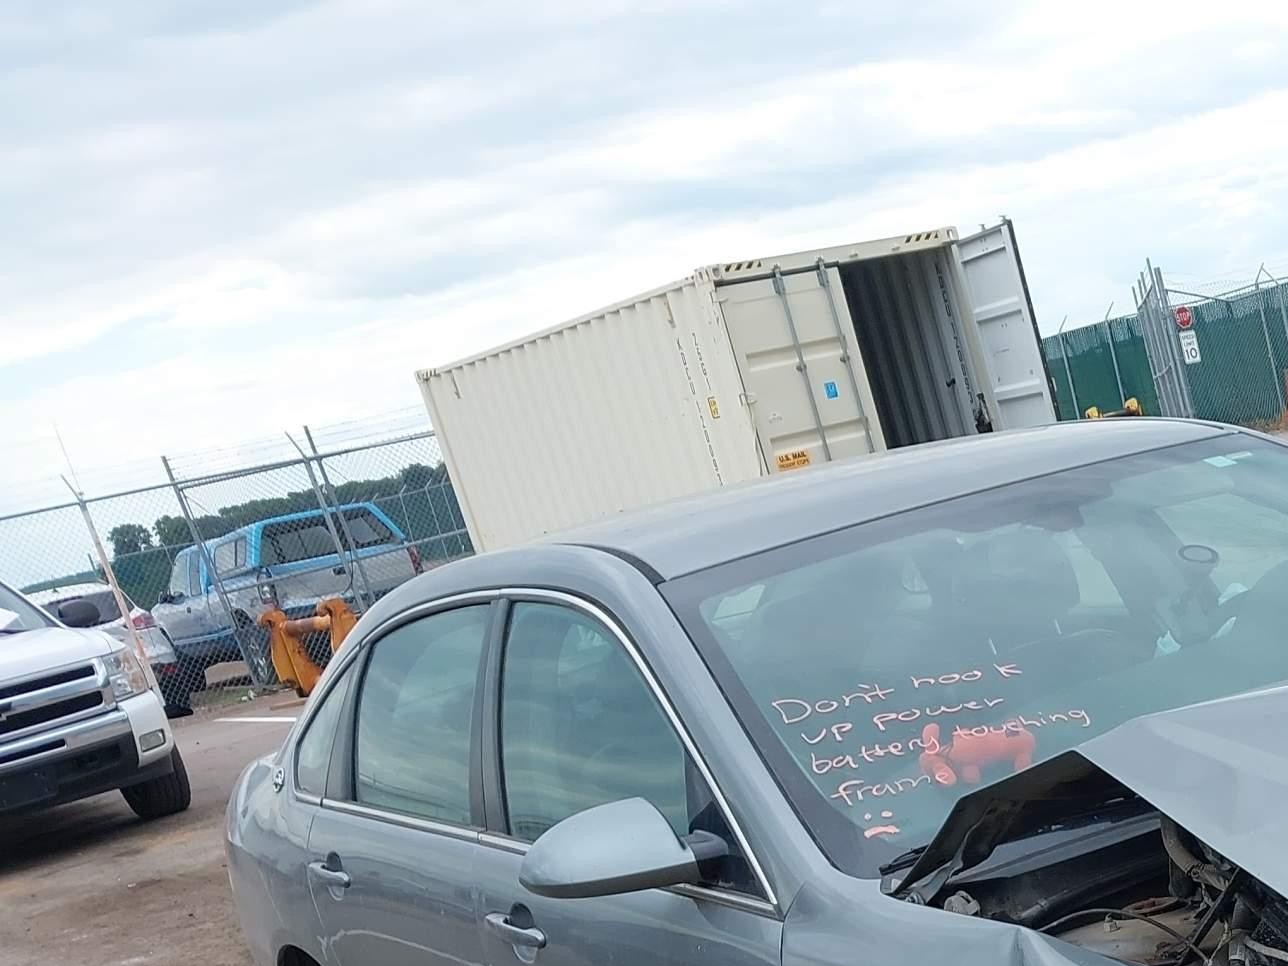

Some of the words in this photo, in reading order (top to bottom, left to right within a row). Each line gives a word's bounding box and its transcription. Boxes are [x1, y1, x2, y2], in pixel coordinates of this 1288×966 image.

[1185, 347, 1198, 360] 10
[778, 454, 791, 463] U.S.
[791, 450, 807, 460] MAIL
[771, 683, 896, 724] Don't
[811, 735, 940, 775] battery
[951, 707, 1091, 741] touching
[830, 772, 950, 806] frame
